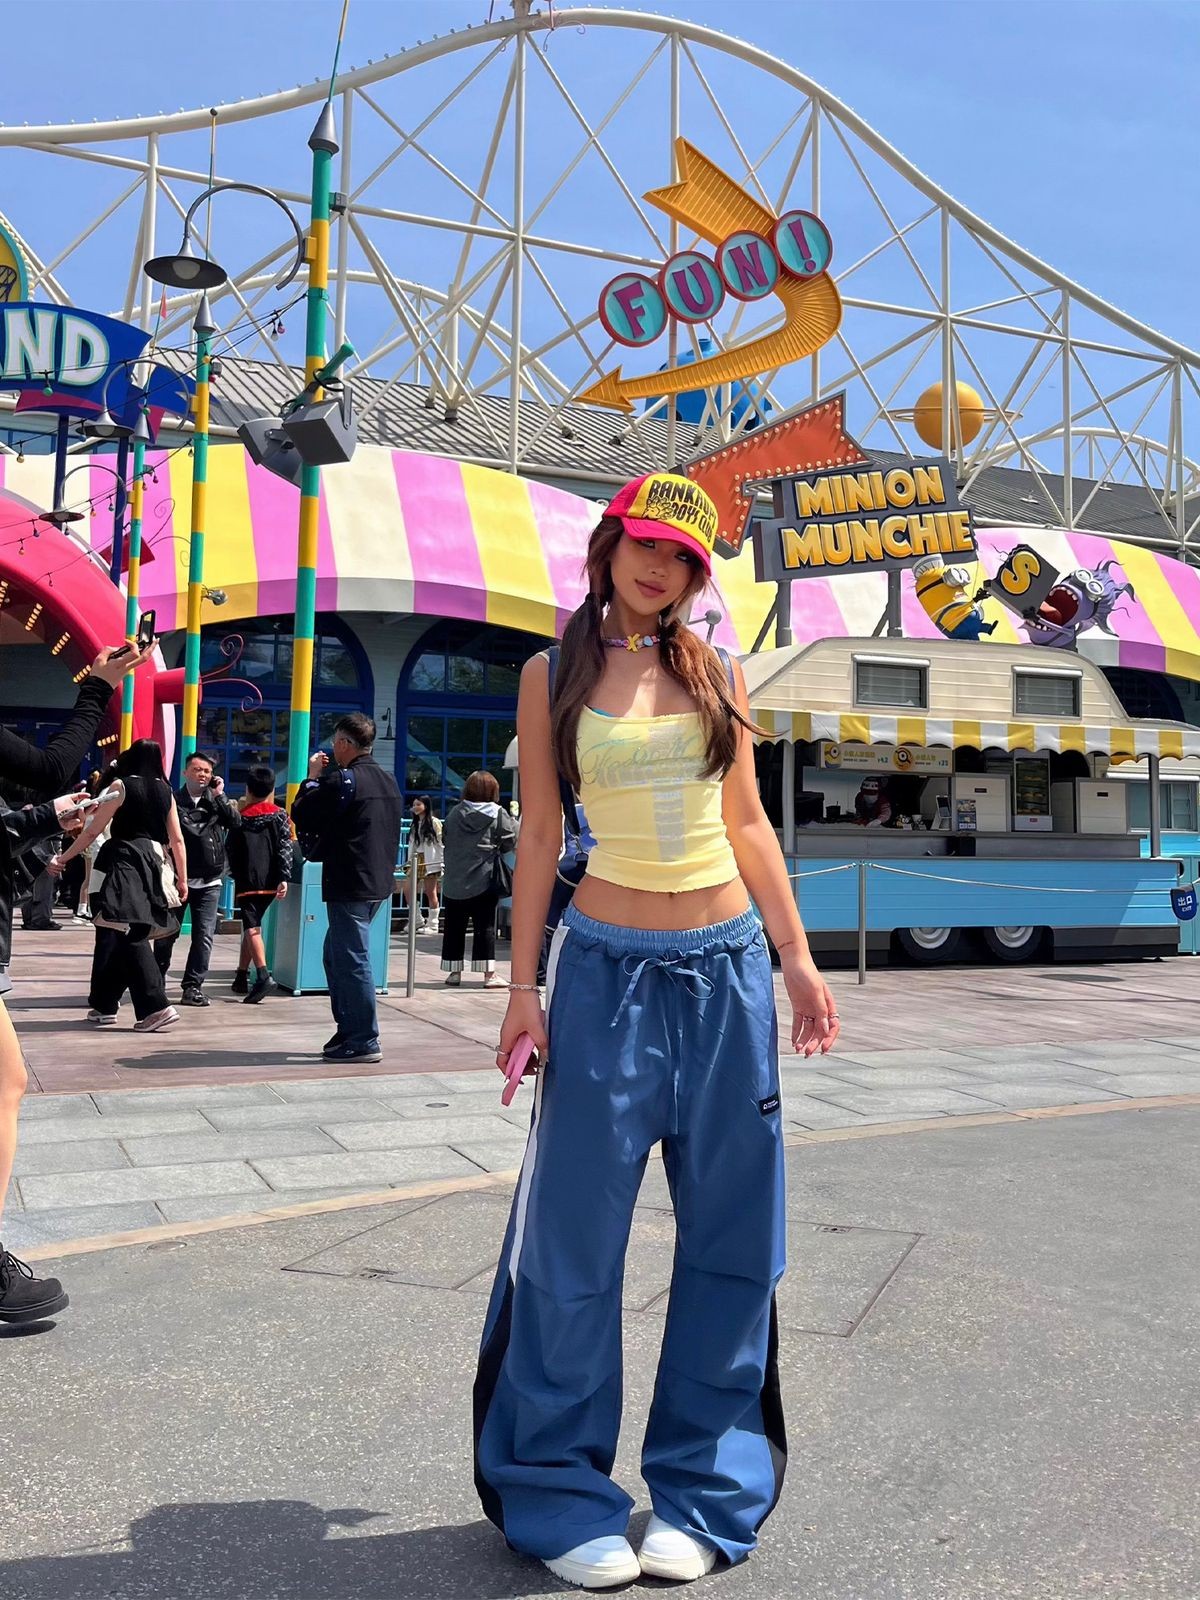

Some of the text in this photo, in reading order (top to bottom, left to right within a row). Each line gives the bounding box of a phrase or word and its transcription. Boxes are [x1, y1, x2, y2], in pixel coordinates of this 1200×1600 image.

[613, 219, 816, 339] FUN!
[0, 308, 110, 386] ND
[796, 465, 945, 518] MINION
[781, 510, 974, 569] MUNCHIE
[1001, 550, 1041, 595] S
[1177, 895, 1192, 906] 出口
